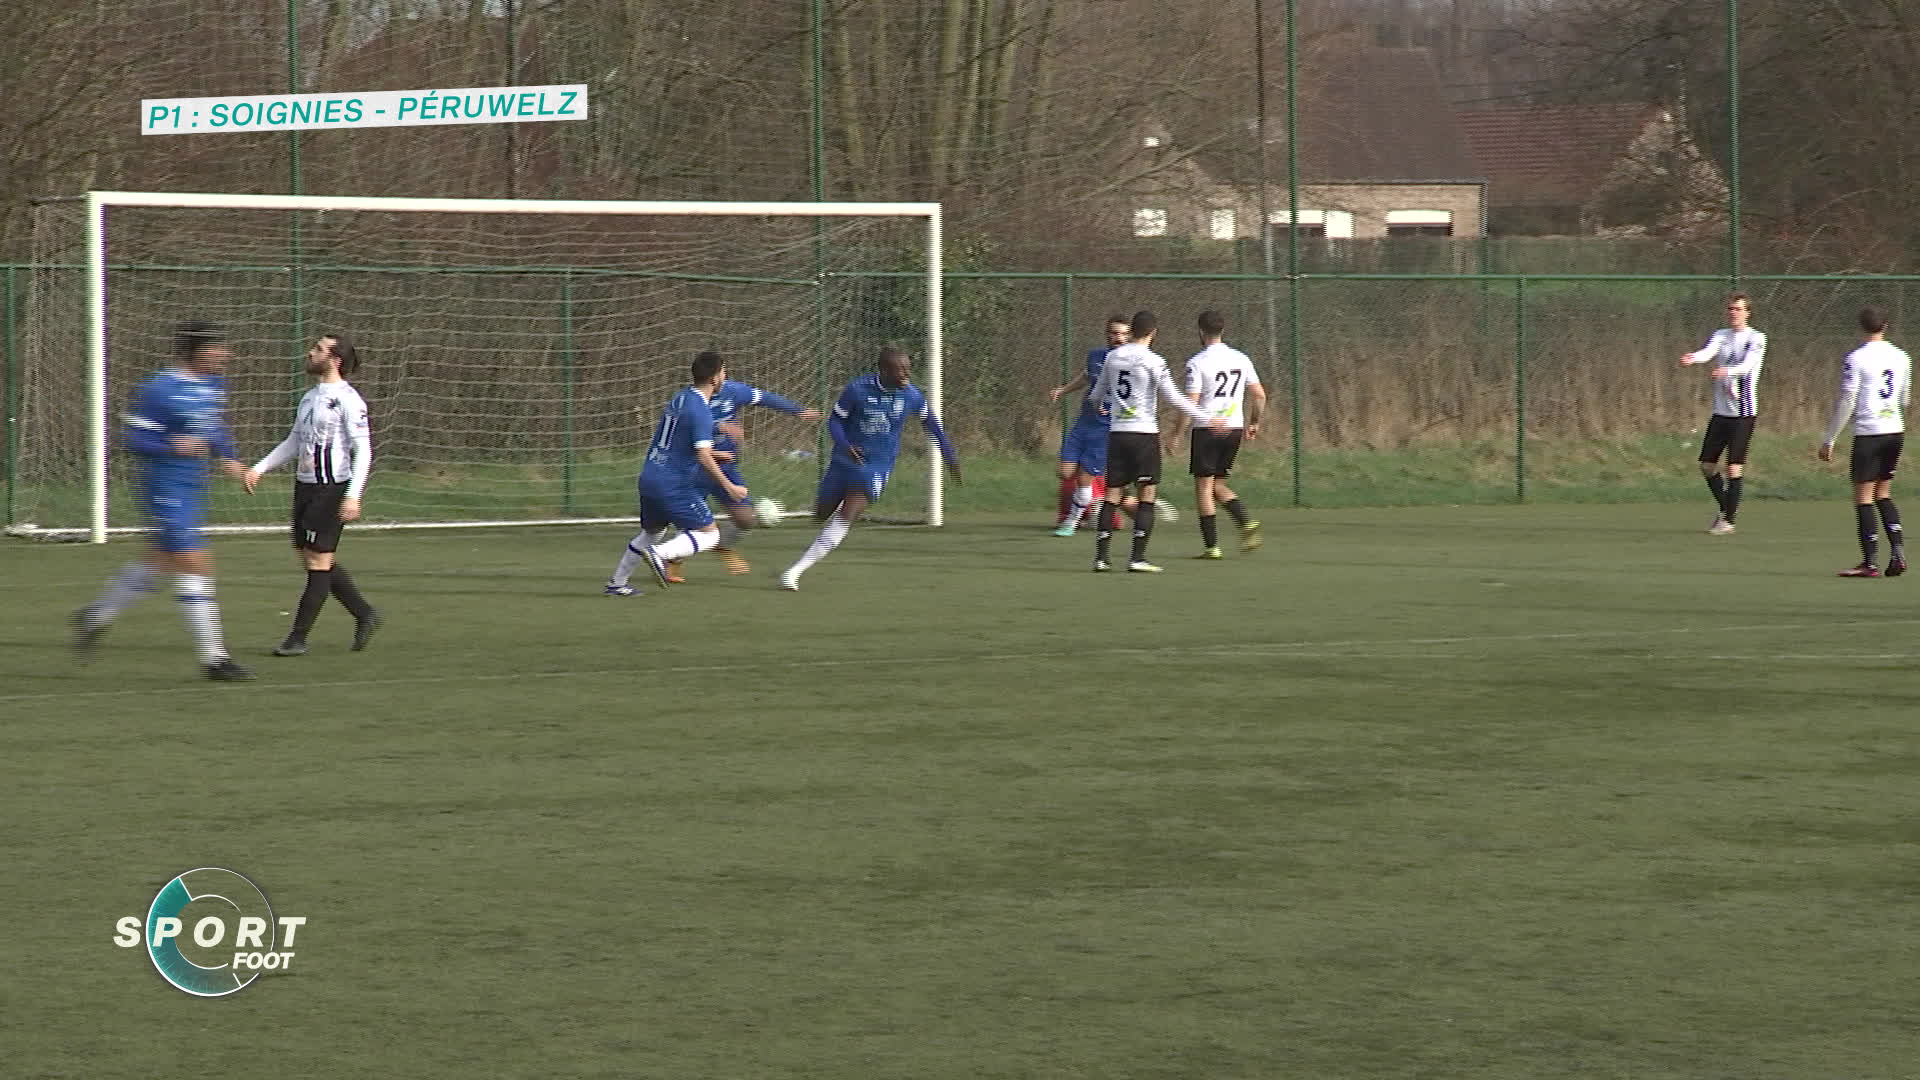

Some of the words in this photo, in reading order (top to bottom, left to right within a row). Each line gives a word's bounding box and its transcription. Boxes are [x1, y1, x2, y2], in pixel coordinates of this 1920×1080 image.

[1116, 370, 1132, 399] 5
[1214, 369, 1241, 397] 27
[1879, 370, 1894, 398] 3
